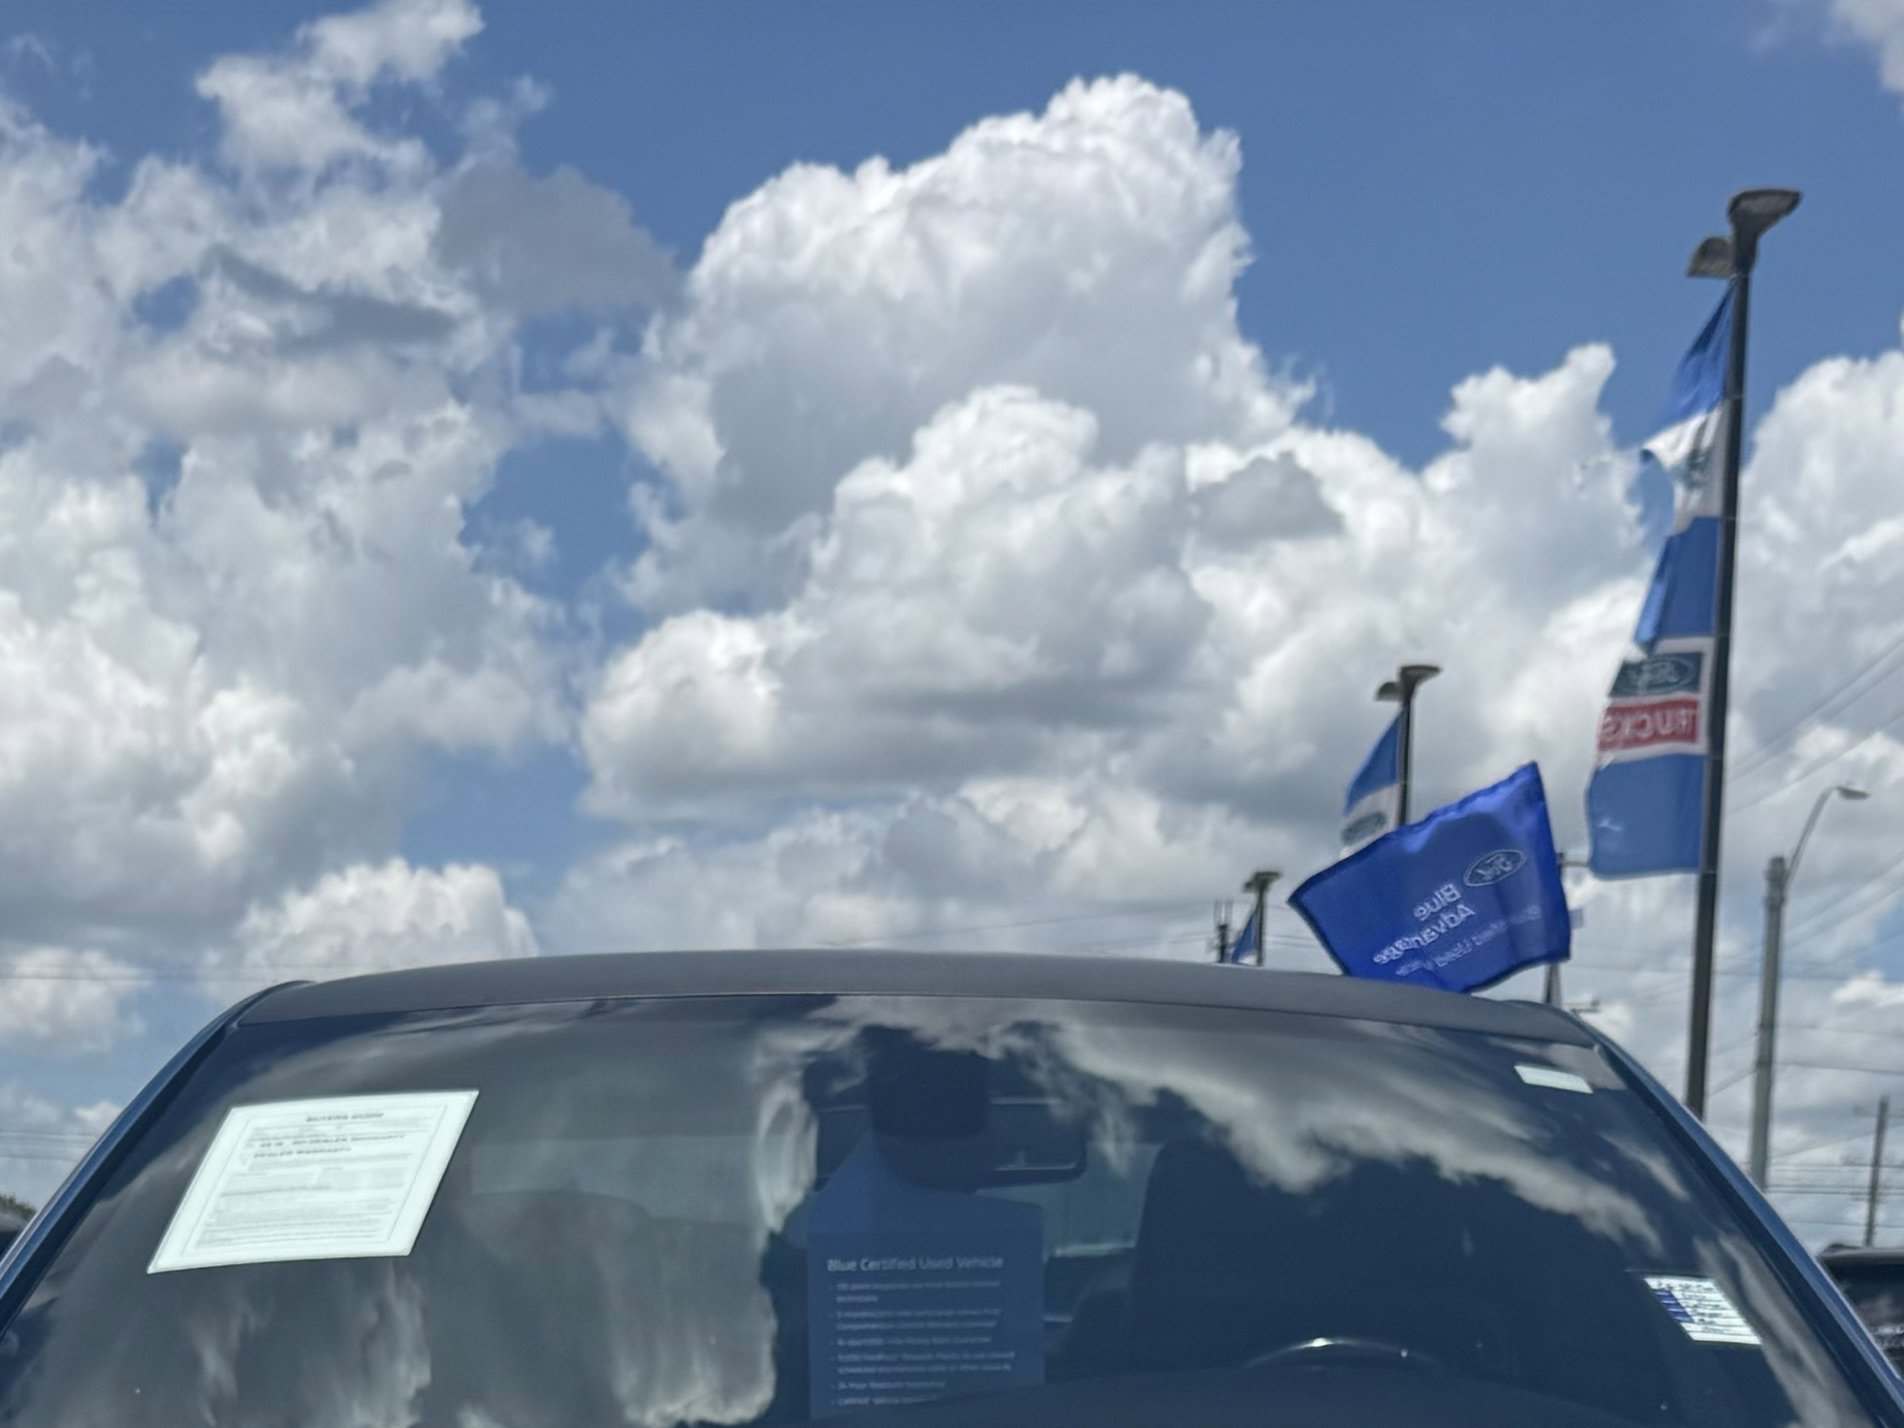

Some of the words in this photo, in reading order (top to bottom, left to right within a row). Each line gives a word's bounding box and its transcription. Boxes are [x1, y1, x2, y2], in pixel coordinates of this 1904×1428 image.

[827, 1258, 857, 1272] Blue
[859, 1257, 917, 1271] Certified
[919, 1257, 953, 1270] Used
[955, 1256, 1004, 1269] Vehicle
